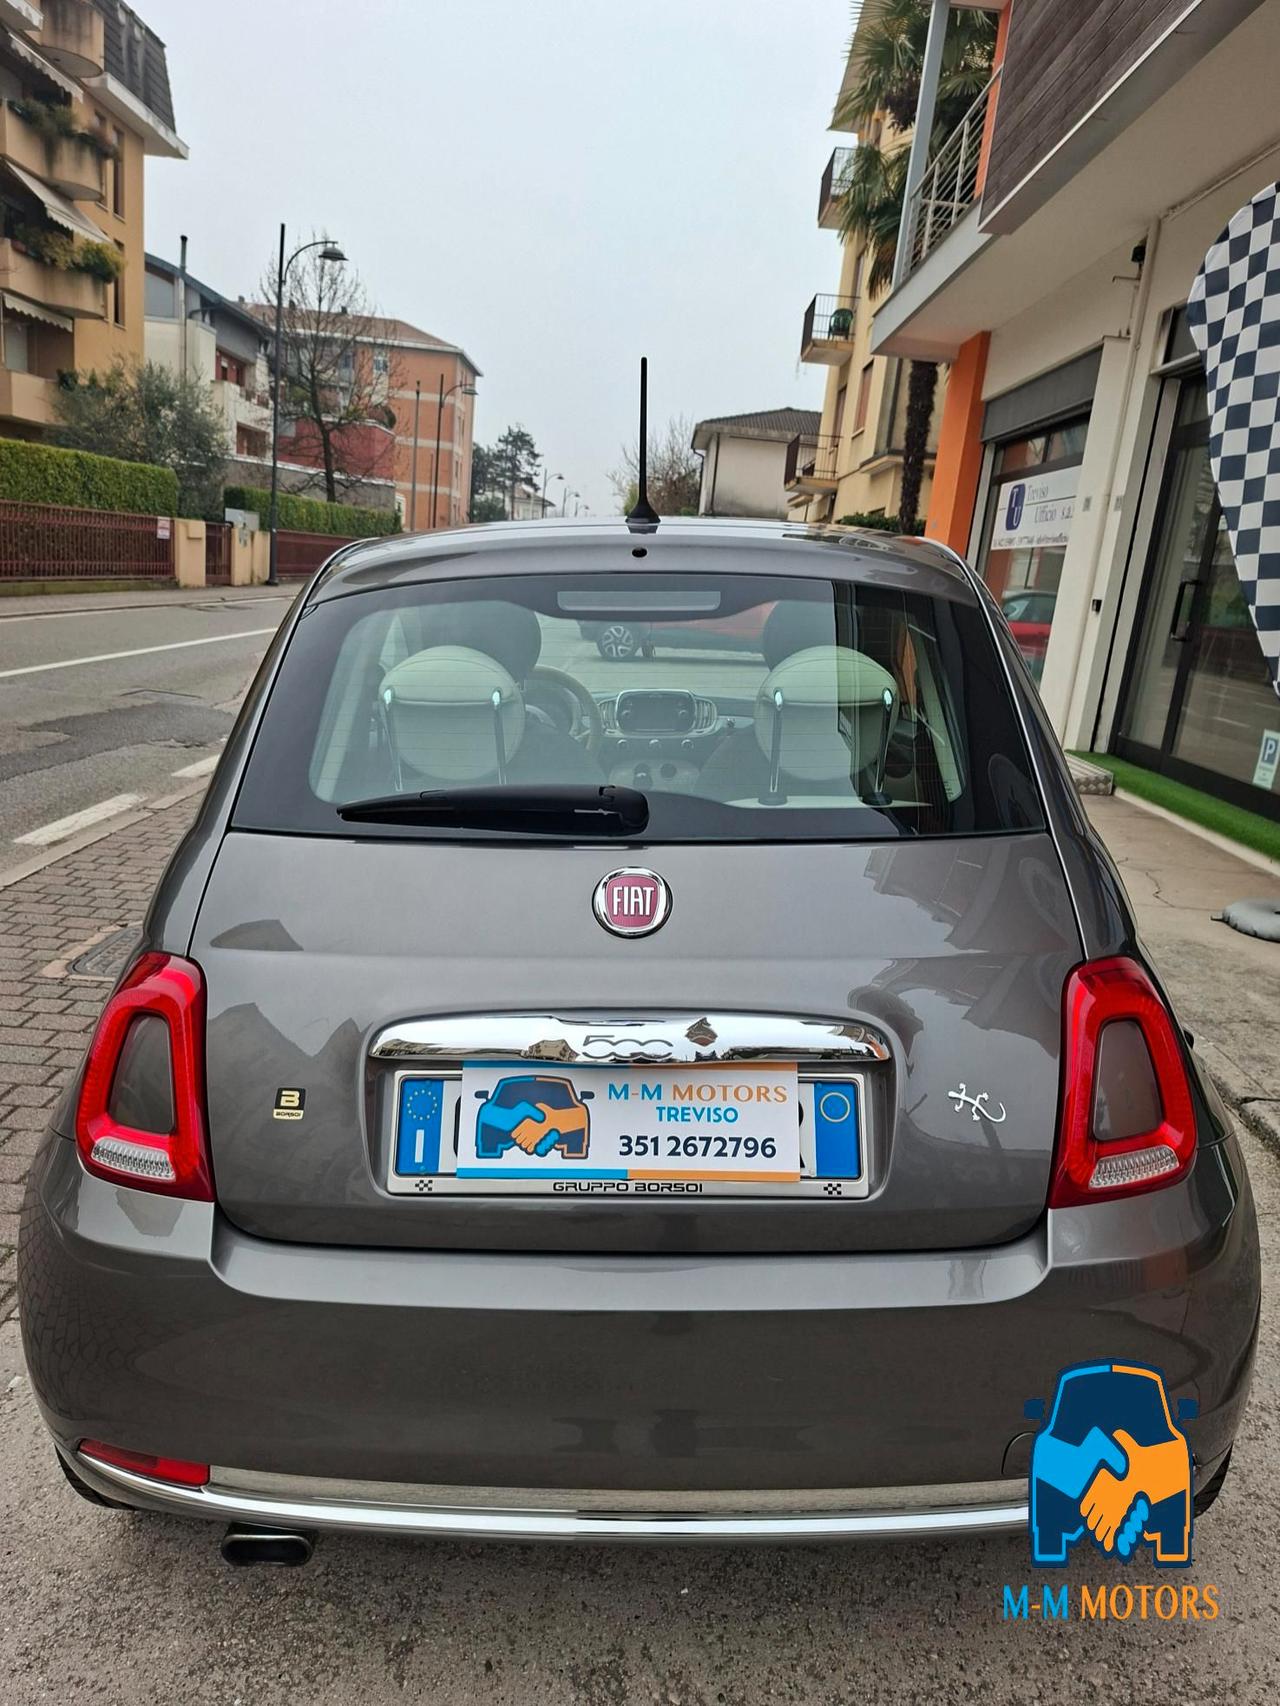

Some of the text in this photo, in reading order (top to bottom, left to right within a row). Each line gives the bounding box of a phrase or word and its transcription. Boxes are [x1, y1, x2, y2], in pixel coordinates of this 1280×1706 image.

[1264, 739, 1276, 761] P
[613, 886, 655, 916] FIAT
[582, 1035, 674, 1060] 500
[608, 1083, 788, 1103] M-M MOTORS
[656, 1106, 739, 1123] TREVISO
[553, 1182, 703, 1193] GRUPPO BORSOI
